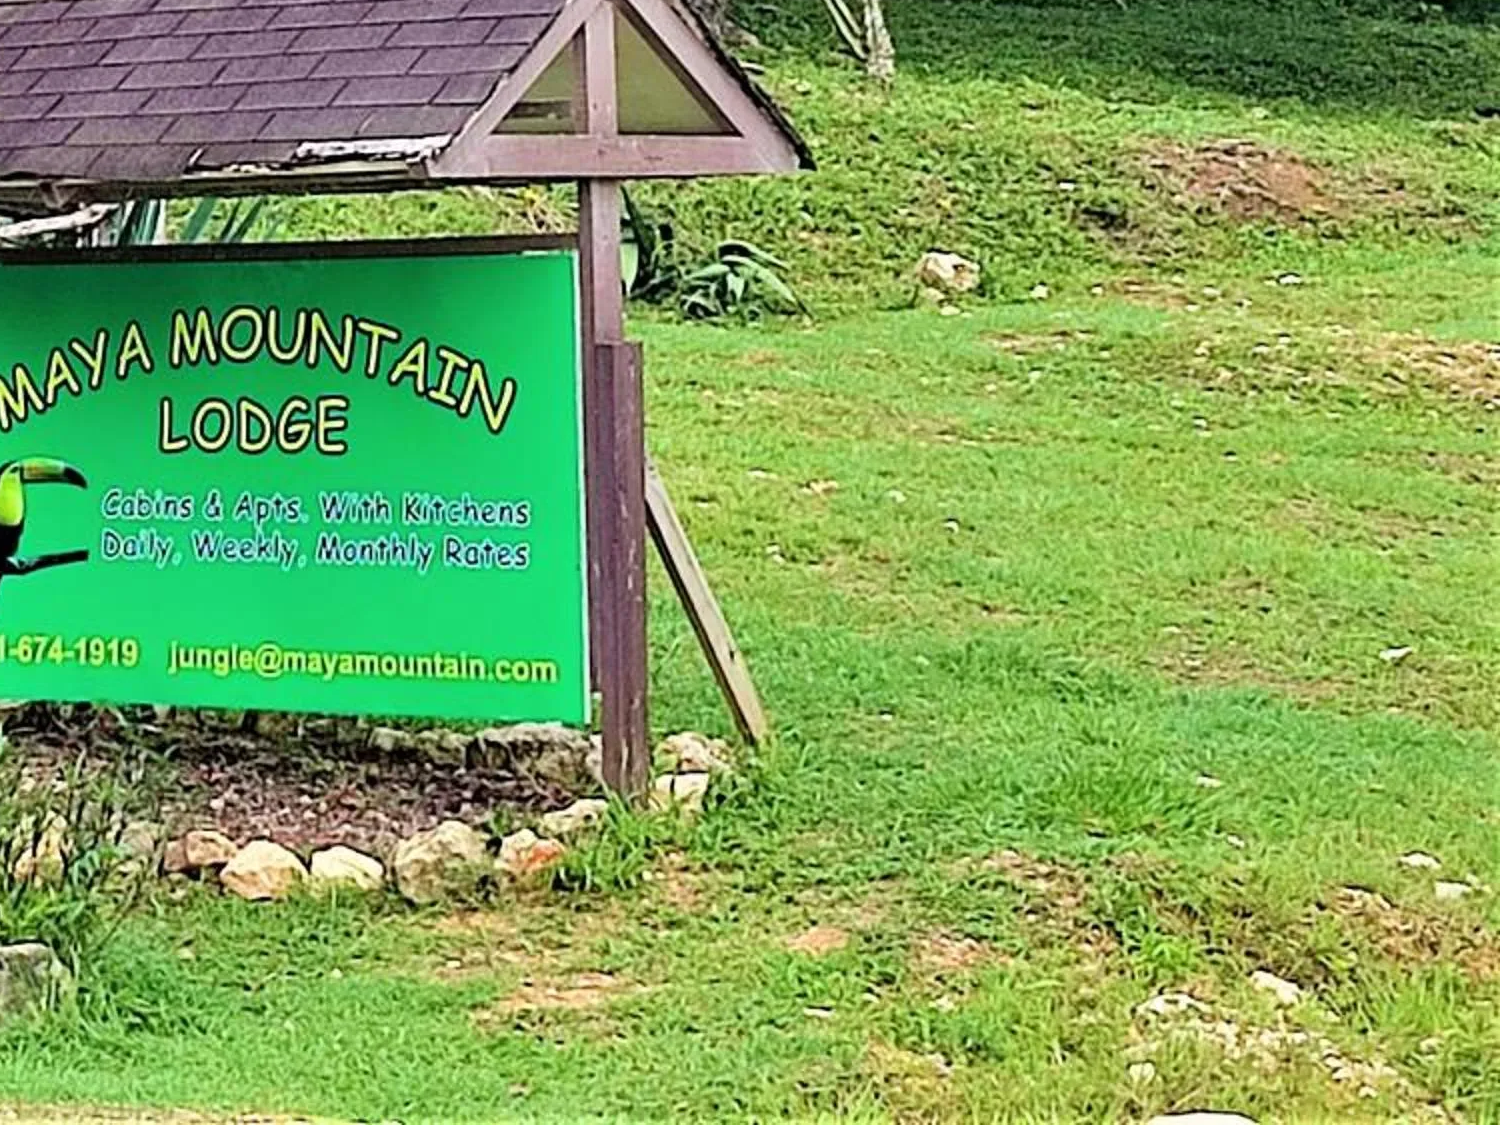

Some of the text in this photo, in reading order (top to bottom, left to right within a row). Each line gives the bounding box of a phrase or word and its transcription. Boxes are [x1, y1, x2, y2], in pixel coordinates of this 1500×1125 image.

[170, 307, 517, 432] MOUNTAIN
[159, 397, 350, 454] LODGE
[101, 489, 191, 520] Cabins
[204, 489, 222, 519] &
[320, 490, 391, 522] With
[402, 491, 529, 525] Kitchens
[101, 531, 528, 573] Daily, Weekly, Monthly Rates
[167, 638, 557, 683] jungle@mayamountain.com
